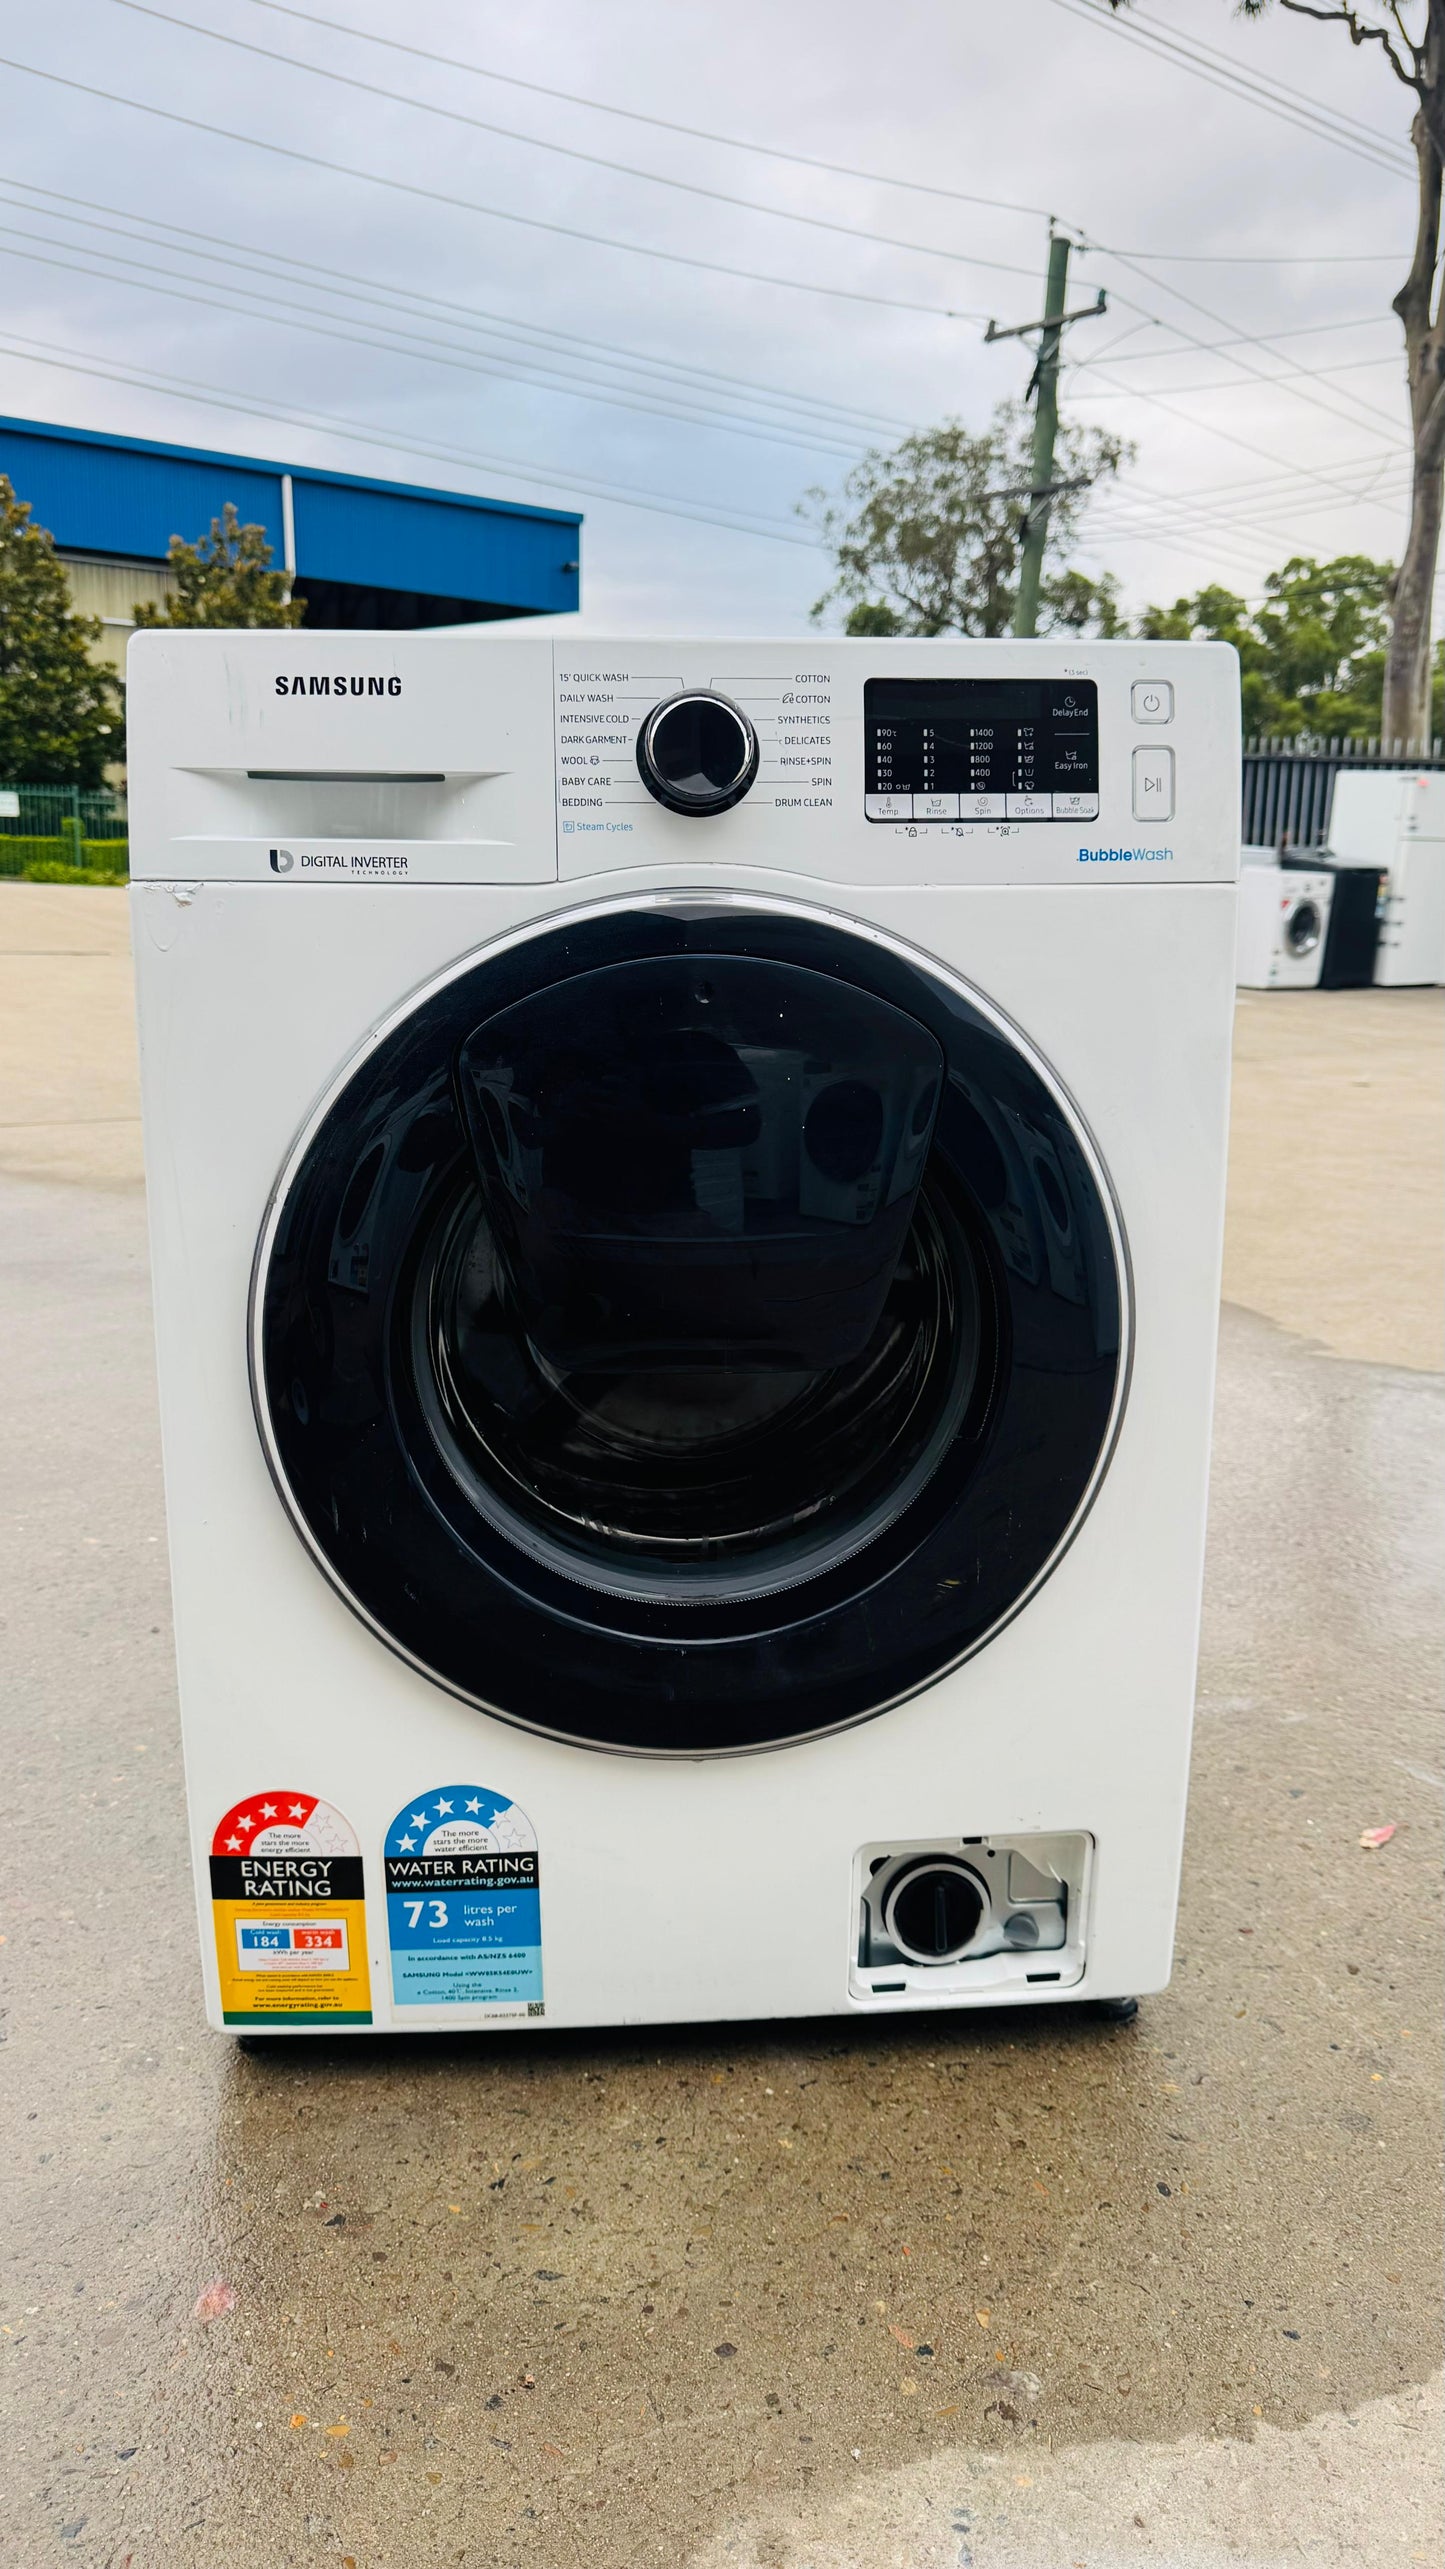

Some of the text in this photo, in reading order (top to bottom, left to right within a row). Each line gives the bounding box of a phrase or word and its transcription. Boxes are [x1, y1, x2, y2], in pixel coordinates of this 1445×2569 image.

[573, 673, 601, 682] QUICK
[602, 673, 628, 682] WASH
[795, 675, 830, 683] COTTON
[275, 676, 402, 696] SAMSUNG
[560, 694, 614, 702] DAILY WASH
[796, 696, 830, 704] COTTON
[1052, 708, 1088, 718] Delay End
[560, 715, 629, 723] INTENSIVE COLD
[778, 716, 830, 724] SYNTHETICS
[561, 736, 627, 744] DARK GARMENT
[784, 736, 831, 744] DELICATES
[882, 742, 892, 750] 60
[975, 742, 994, 750] 1200
[561, 756, 588, 764] WOOL
[780, 757, 832, 766] RINSE+SPIN
[1054, 762, 1072, 770] Easy
[562, 778, 612, 786] BABY CARE
[812, 778, 832, 786] SPIN
[562, 798, 602, 806] BEDDING
[775, 798, 832, 807] DRUM CLEAN
[878, 808, 898, 816] Temp
[974, 807, 992, 815] Spin
[1014, 807, 1044, 815] Options
[577, 822, 633, 832] Steam Cycles
[1079, 848, 1174, 862] BubbleWash
[301, 856, 408, 868] DIGITAL INVERTER
[241, 1861, 332, 1877] ENERGY
[389, 1858, 534, 1876] WATER RATING
[392, 1876, 534, 1888] www.waterrating.gov.au
[244, 1880, 332, 1896] RATING
[404, 1900, 448, 1928] 73
[464, 1905, 517, 1916] litres per
[464, 1916, 494, 1926] wash
[253, 1936, 279, 1947] 184
[305, 1936, 332, 1947] 334
